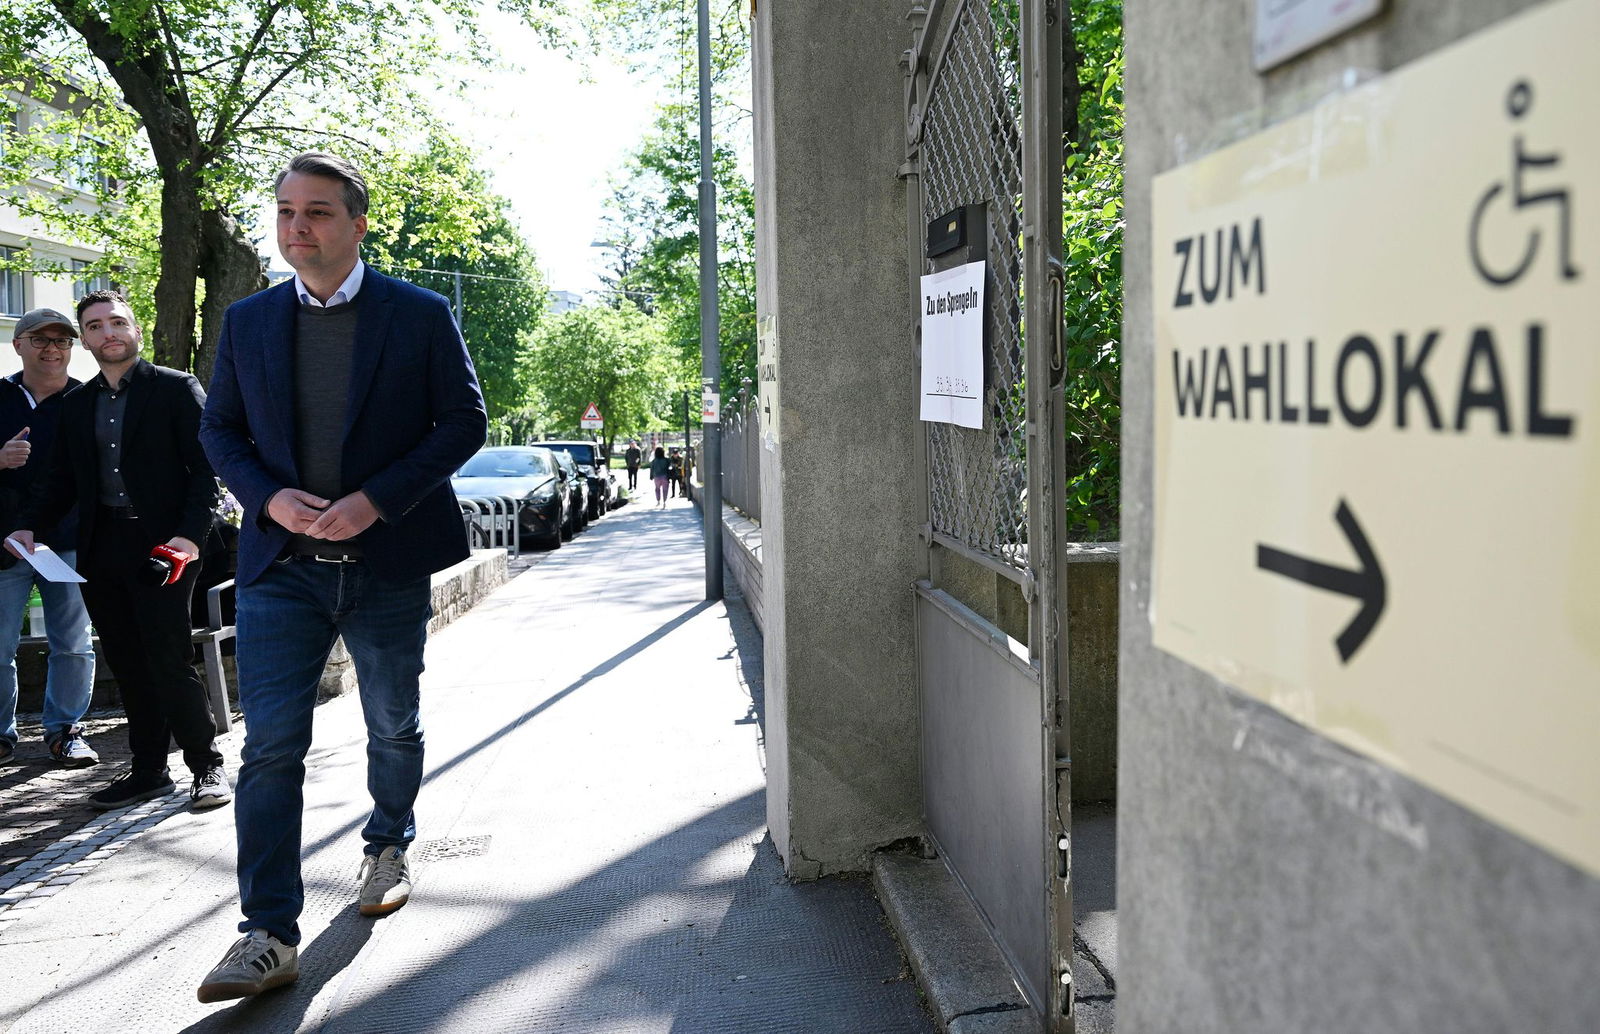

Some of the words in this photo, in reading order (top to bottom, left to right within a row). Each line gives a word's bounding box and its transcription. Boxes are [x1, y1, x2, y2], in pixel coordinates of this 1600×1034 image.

[926, 295, 936, 316] Zu
[937, 294, 946, 315] den
[947, 286, 978, 317] Sprengeln
[1174, 219, 1264, 308] ZUM
[1173, 323, 1576, 440] WAHLLOKAL
